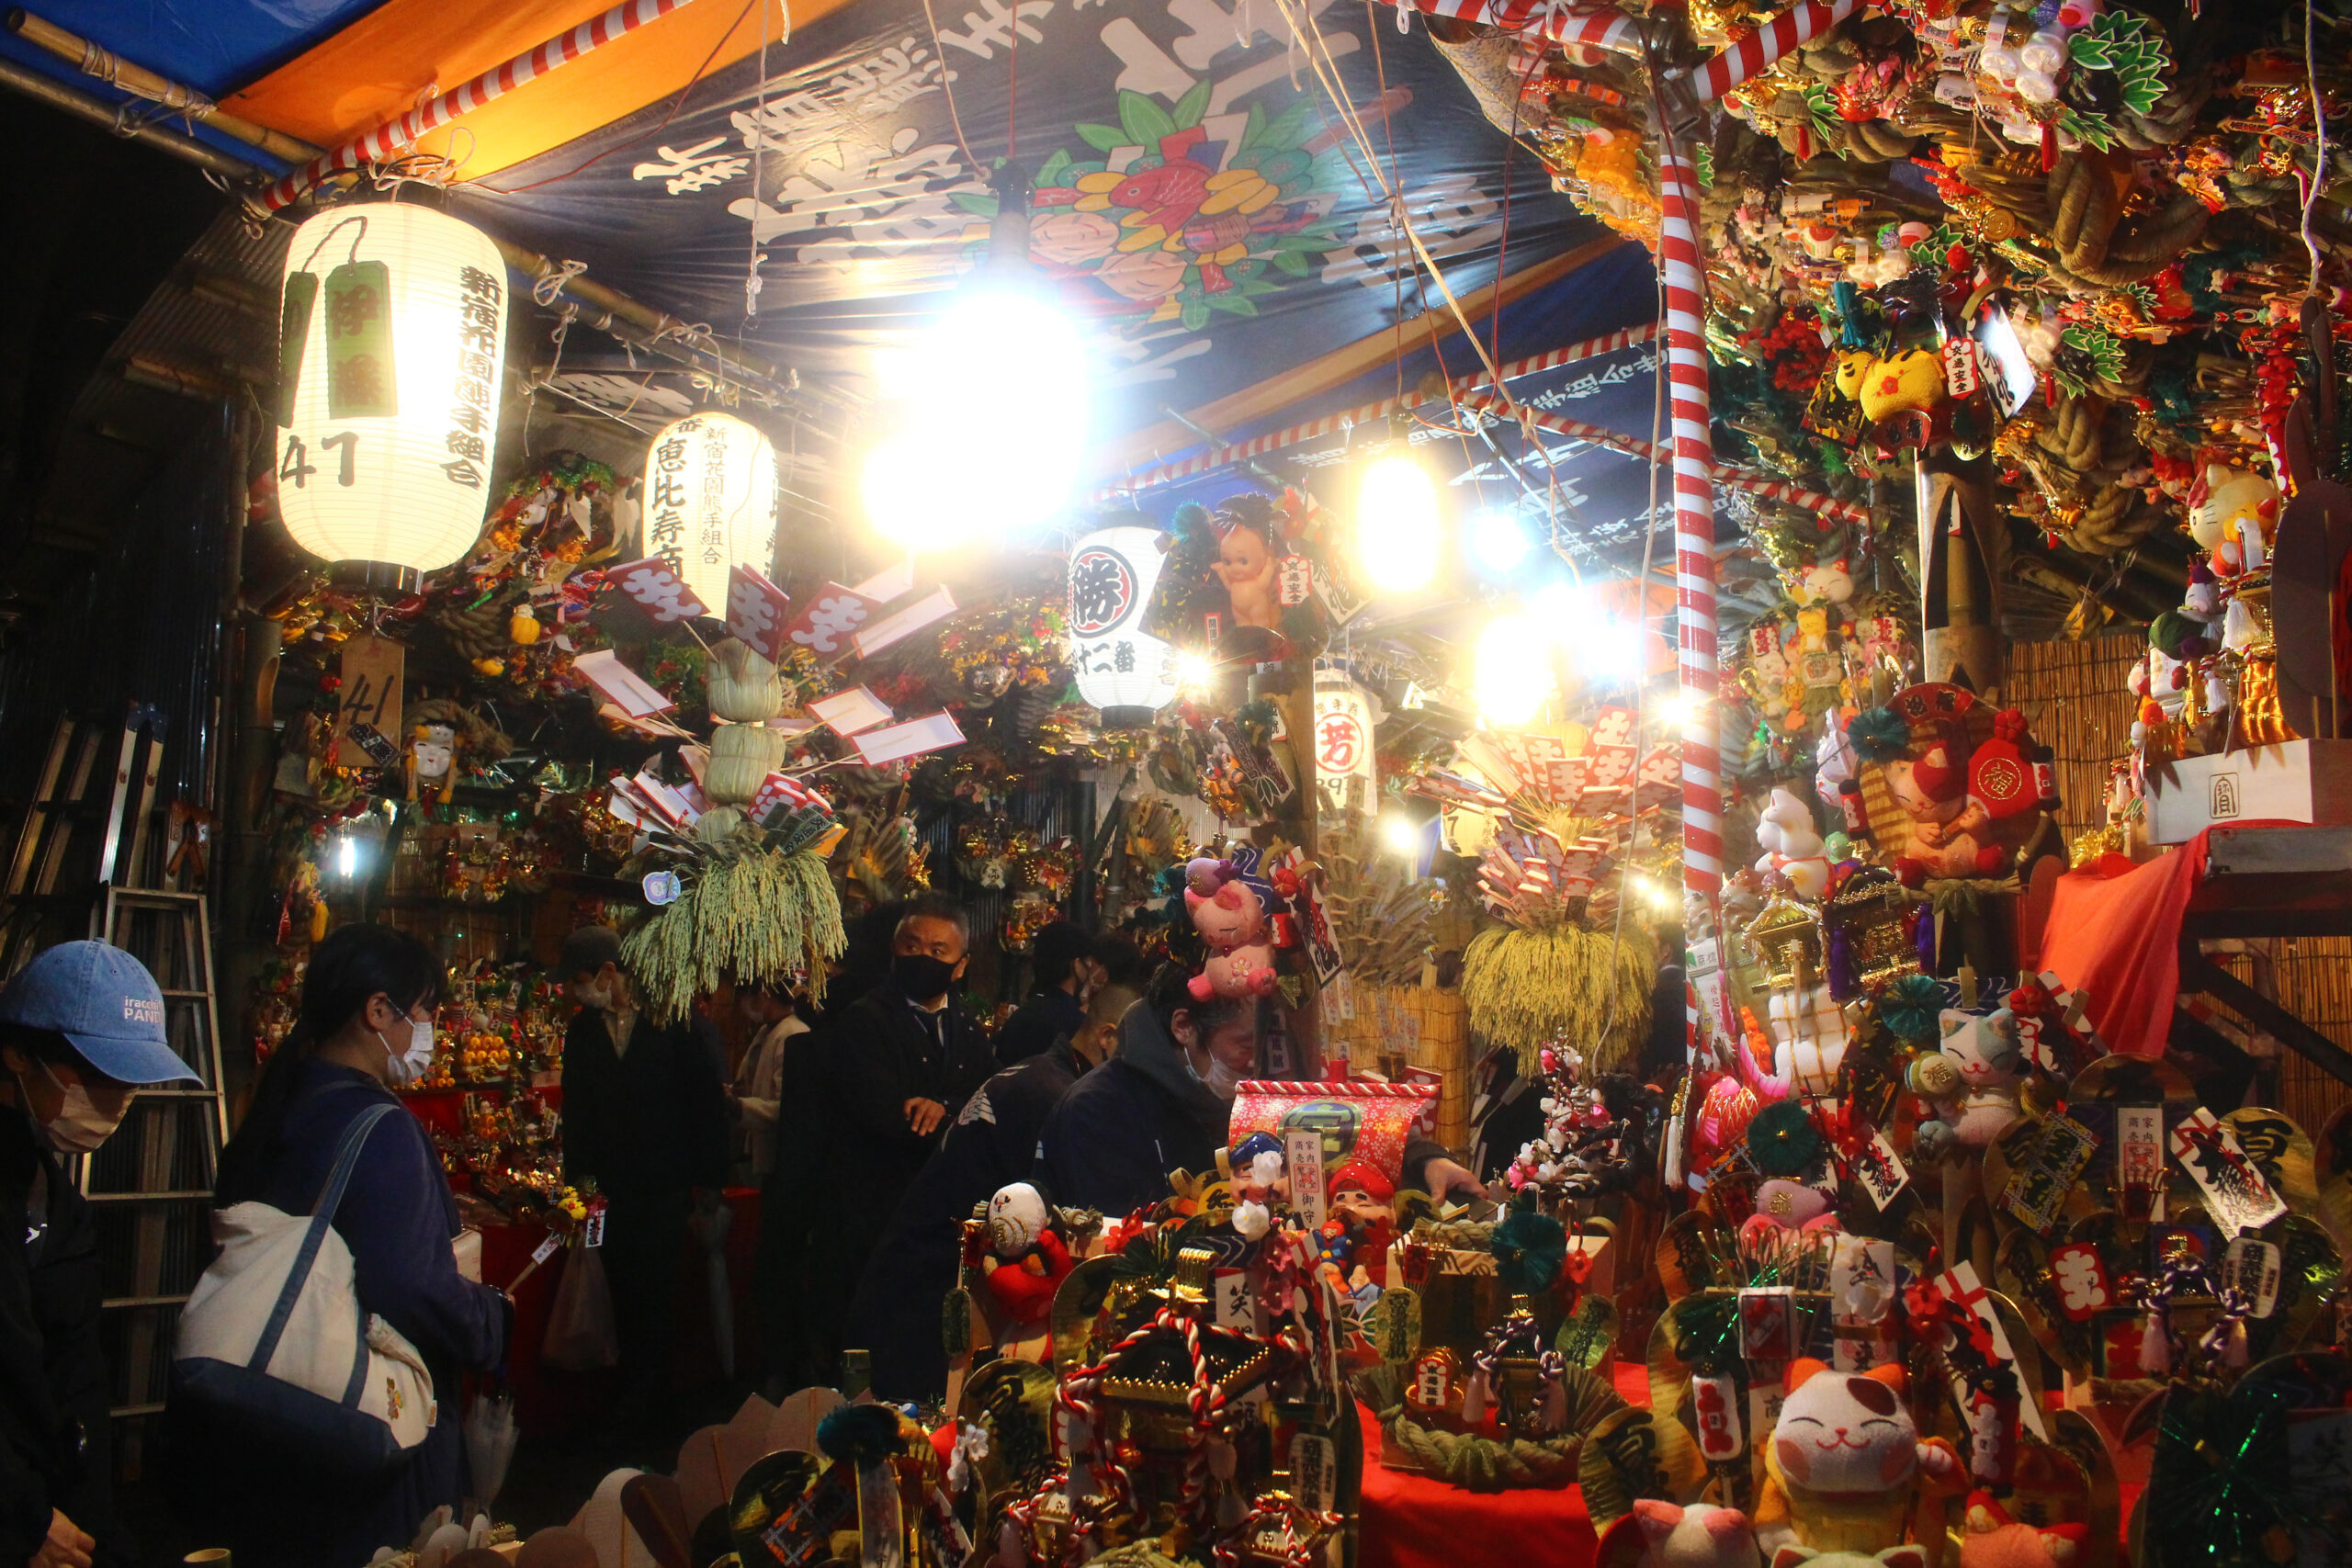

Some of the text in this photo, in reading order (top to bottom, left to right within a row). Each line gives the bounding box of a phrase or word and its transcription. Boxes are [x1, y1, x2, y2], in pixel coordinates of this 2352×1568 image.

[1952, 346, 1967, 392] 交通安全
[700, 426, 729, 565] 新宿花園熊手組合
[342, 673, 395, 725] 41
[1302, 1193, 1315, 1224] 御守
